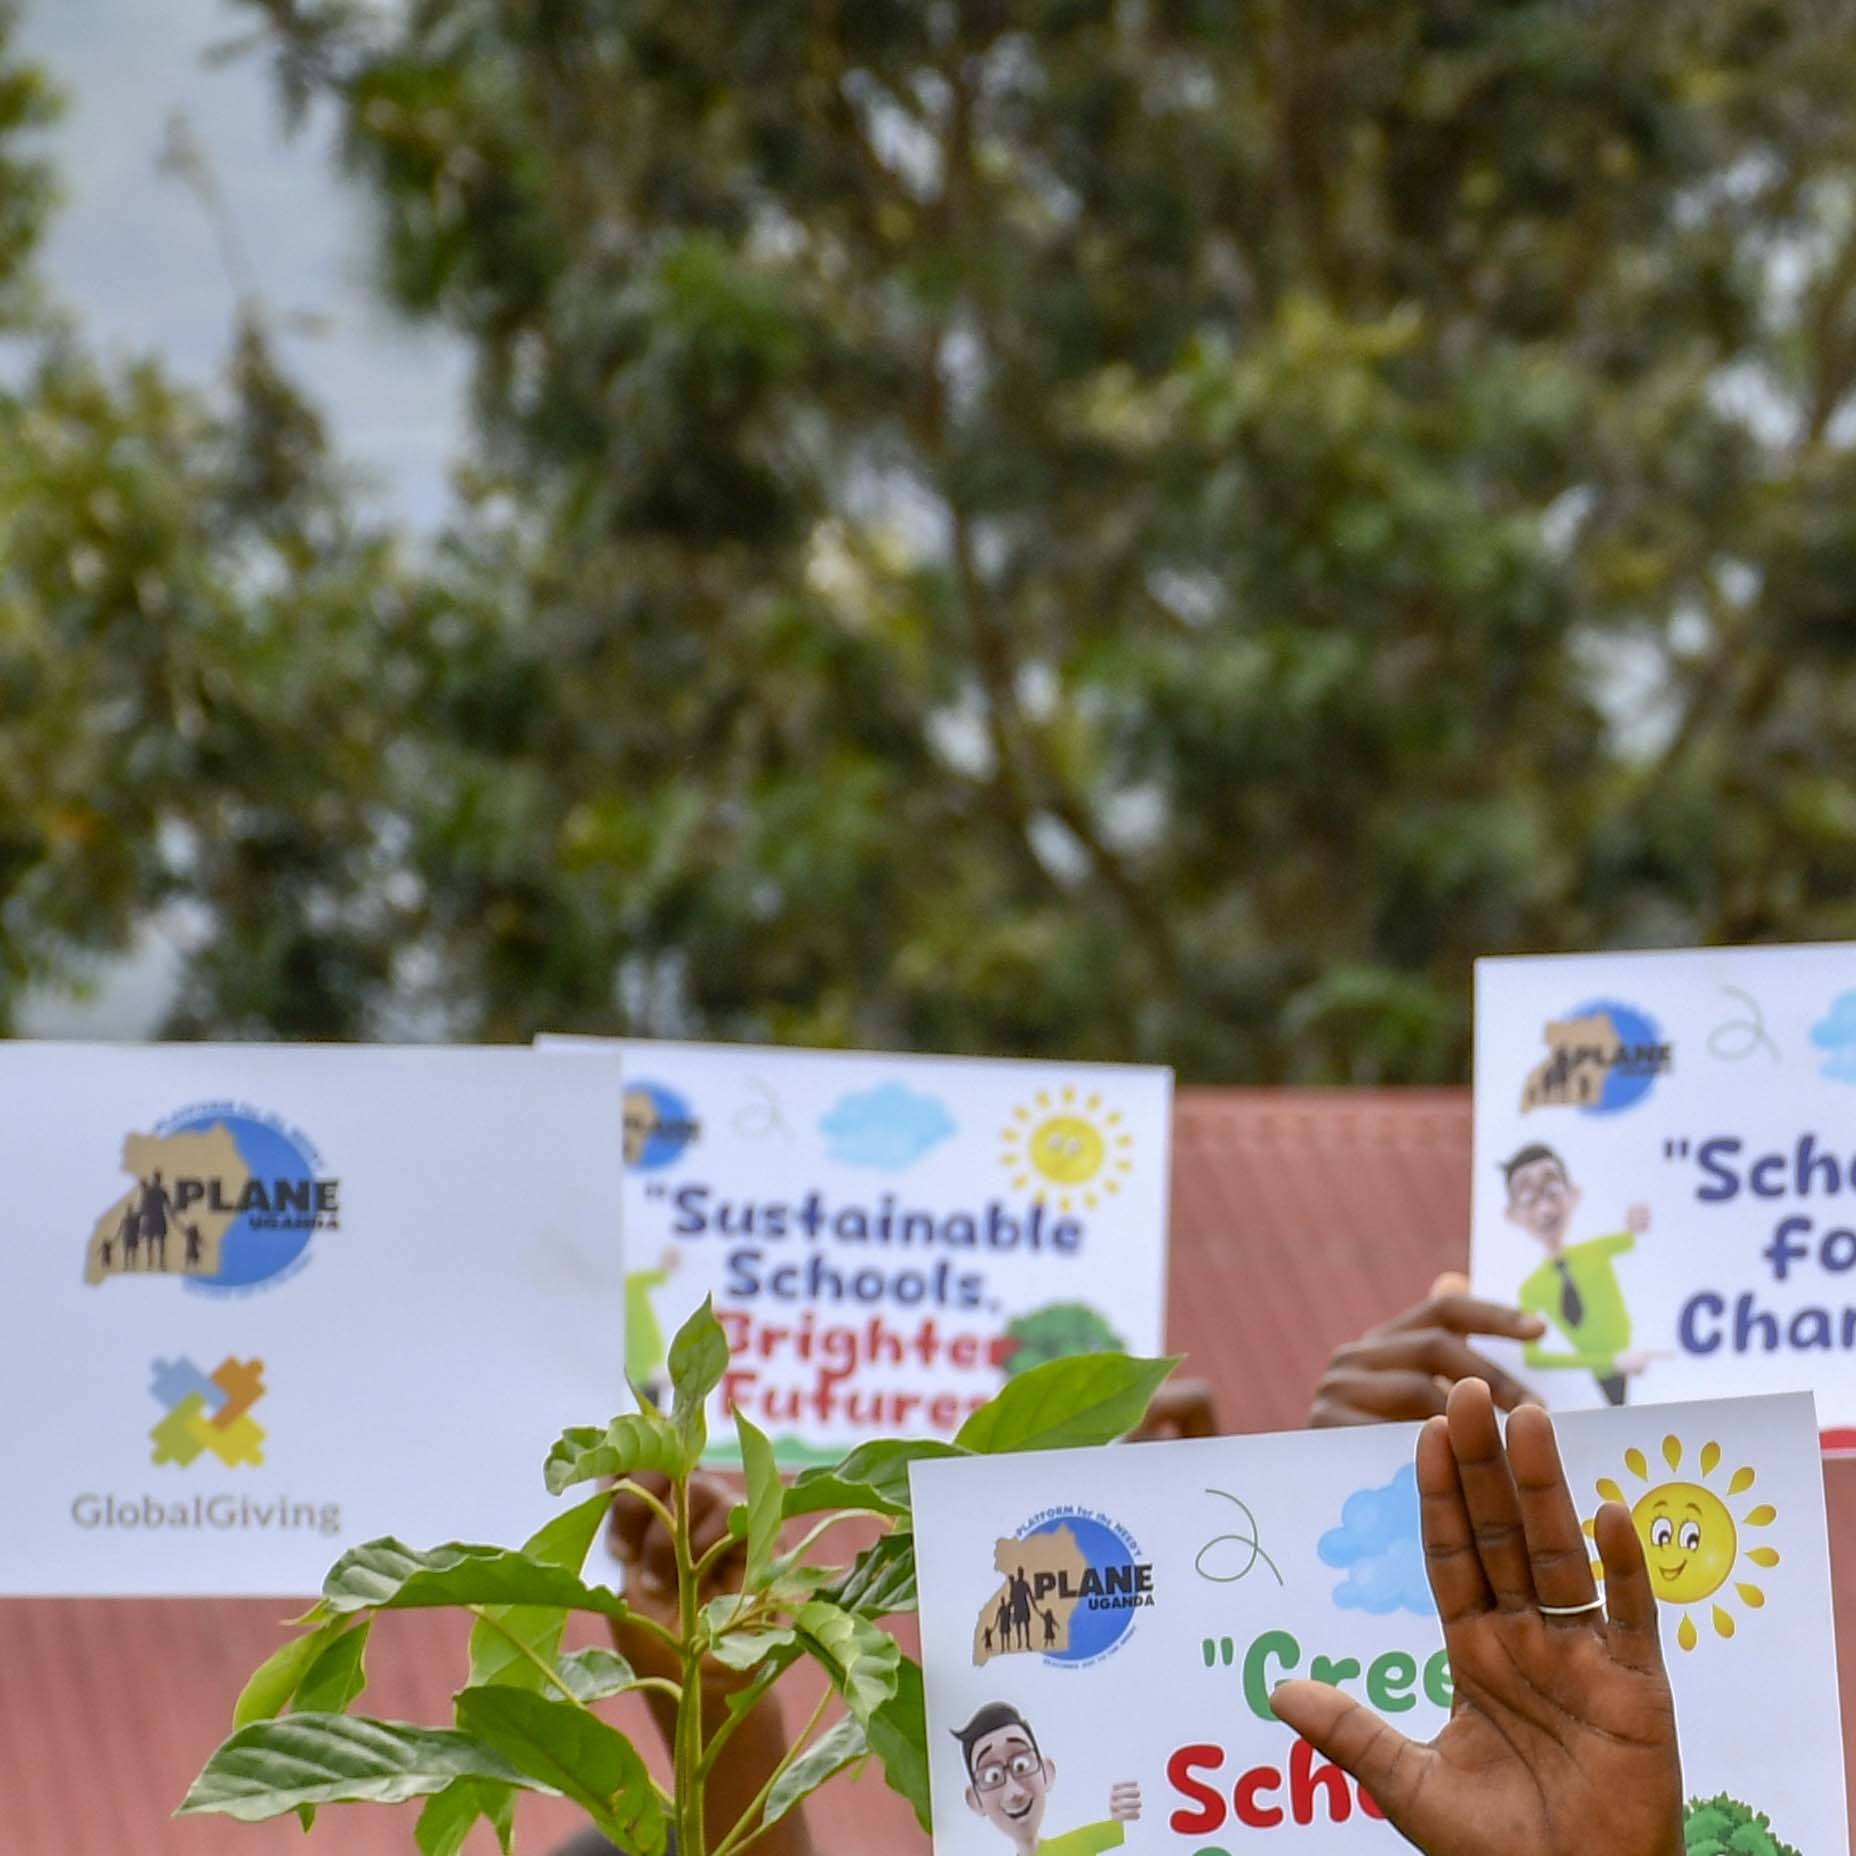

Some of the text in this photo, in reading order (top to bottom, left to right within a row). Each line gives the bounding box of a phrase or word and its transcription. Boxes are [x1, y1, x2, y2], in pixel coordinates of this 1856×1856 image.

[173, 1179, 338, 1213] PLANE
[645, 1183, 1083, 1254] "Sustainable
[71, 1493, 342, 1533] GlobalGiving
[1016, 1505, 1074, 1536] PLATFORM
[1034, 1564, 1154, 1600] PLANE
[1089, 1594, 1154, 1610] UGANDA
[1202, 1629, 1453, 1722] "Gree
[1166, 1739, 1389, 1835] Sch
